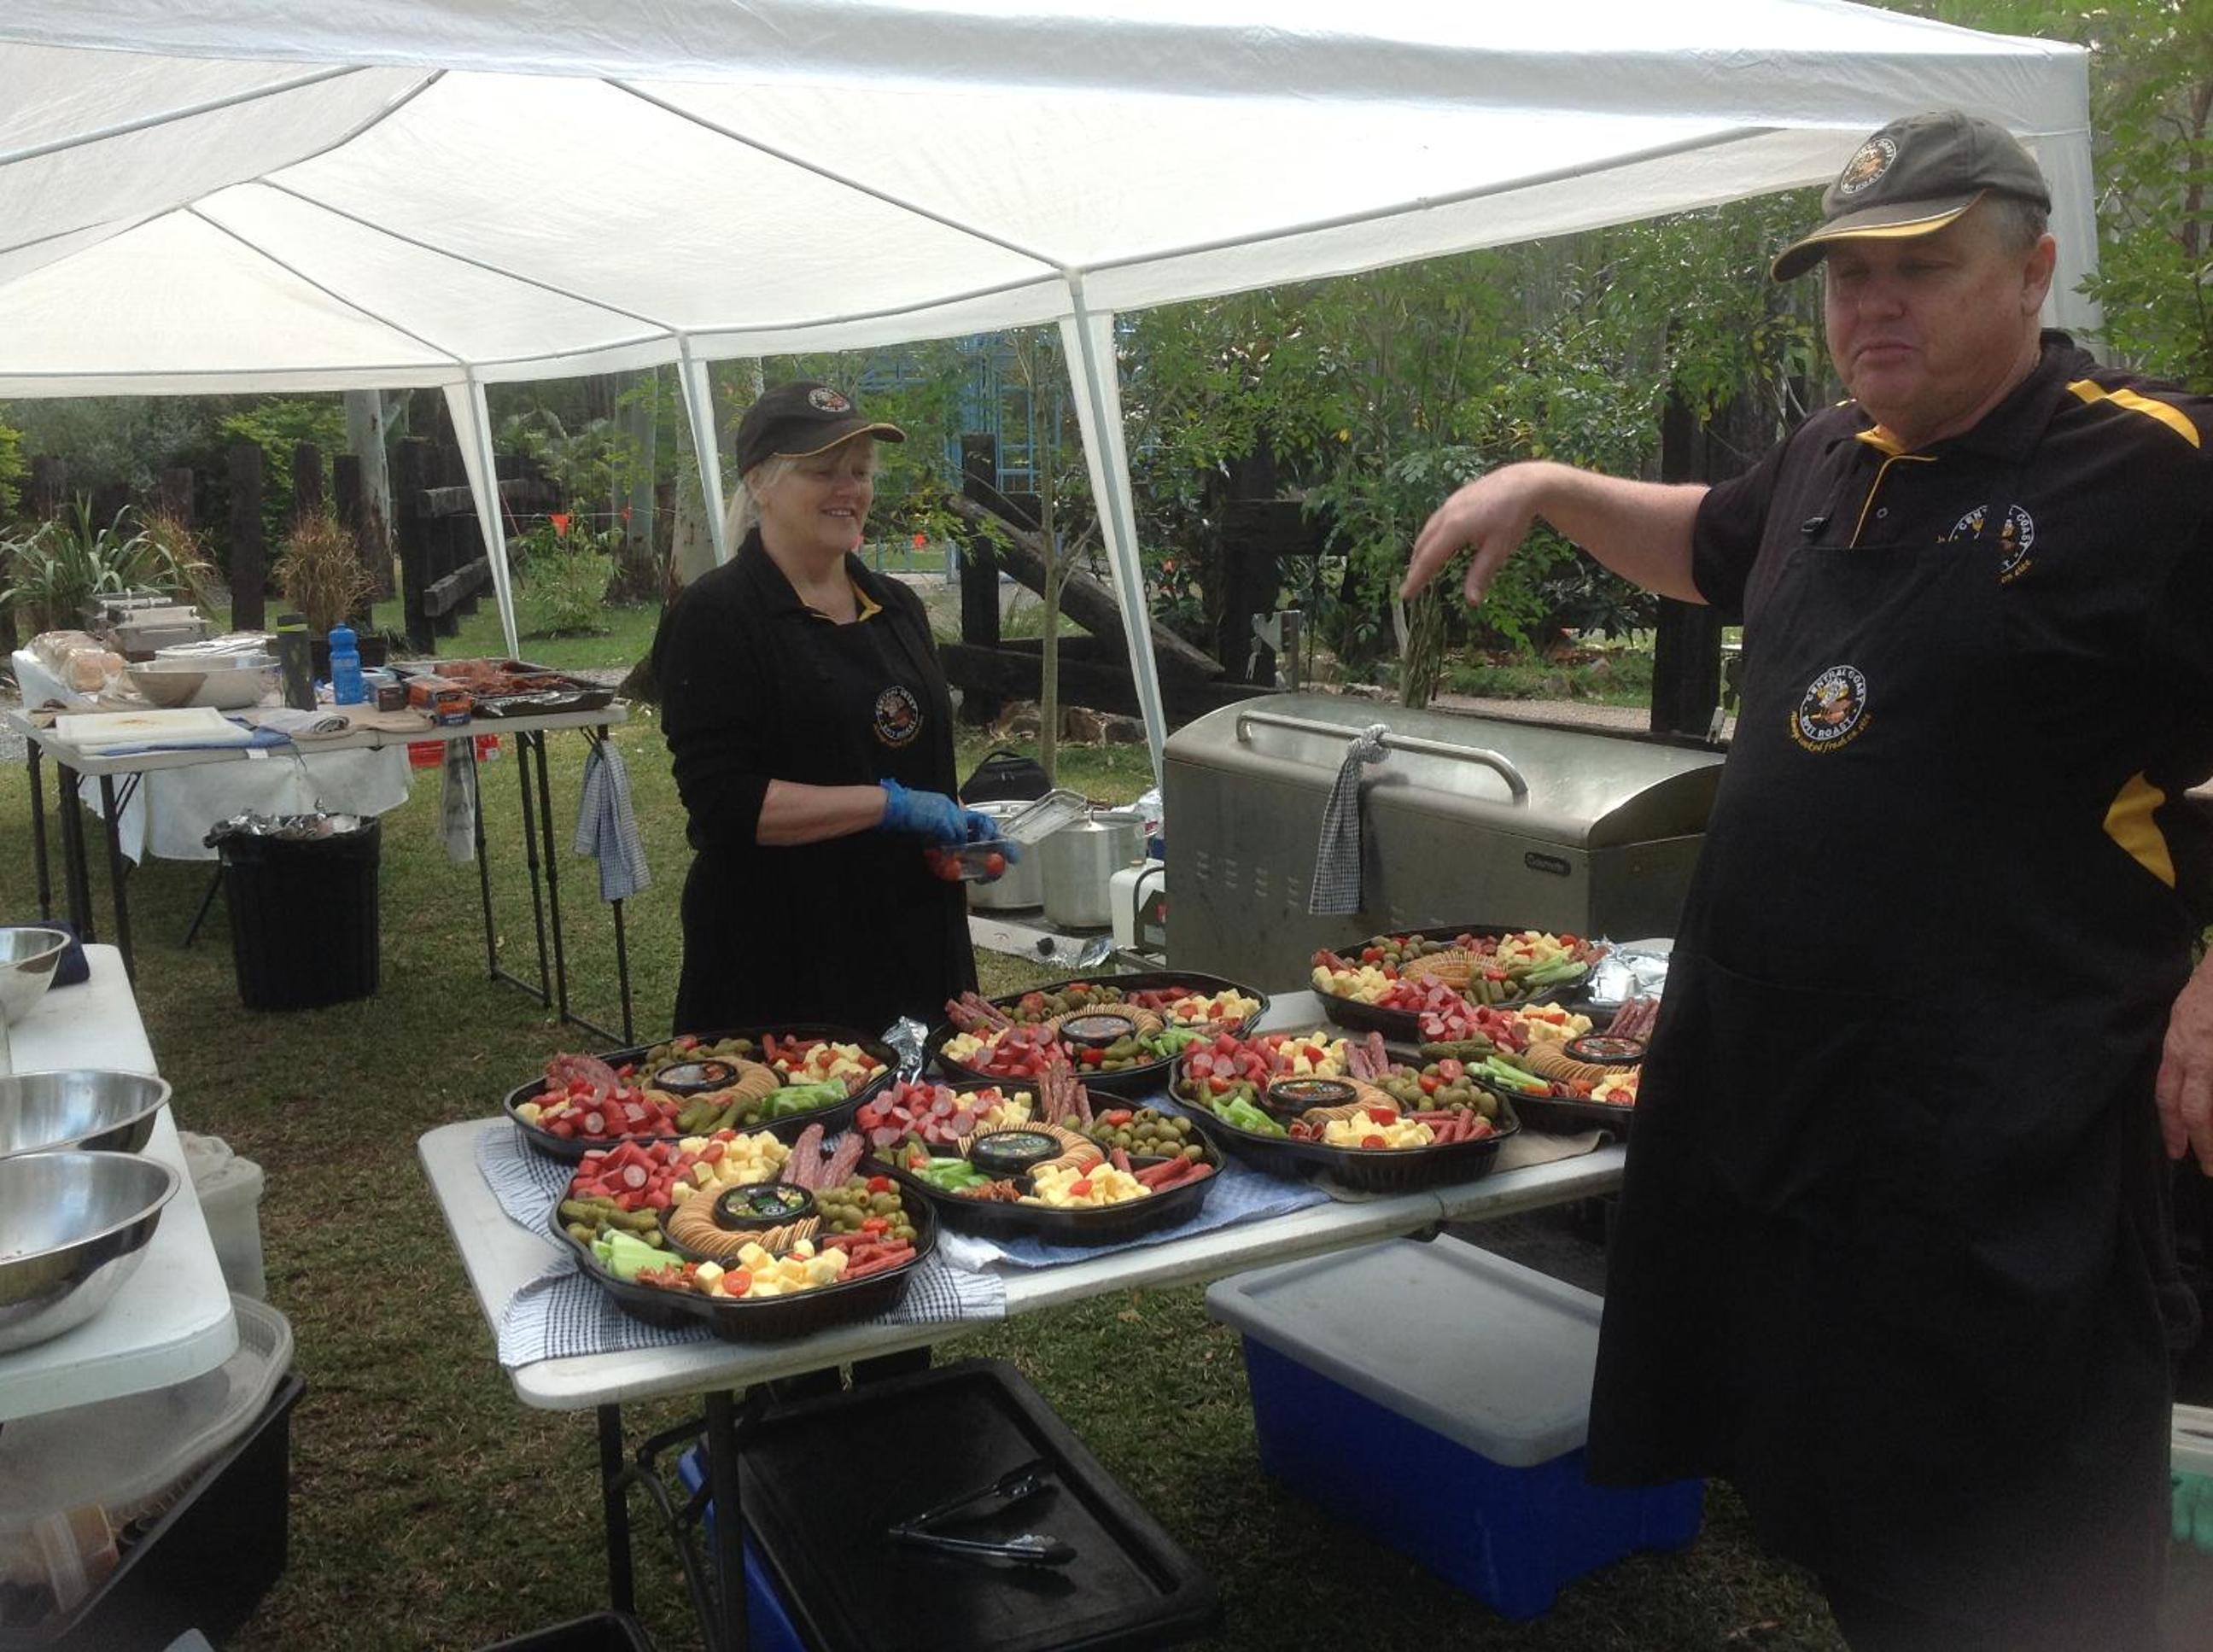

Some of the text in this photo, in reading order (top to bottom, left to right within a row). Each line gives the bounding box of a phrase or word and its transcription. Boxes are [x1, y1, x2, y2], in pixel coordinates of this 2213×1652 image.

[2016, 514, 2030, 547] COAST
[1806, 668, 1866, 702] CENTRAL COAST
[1801, 715, 1854, 738] SPIT ROAST
